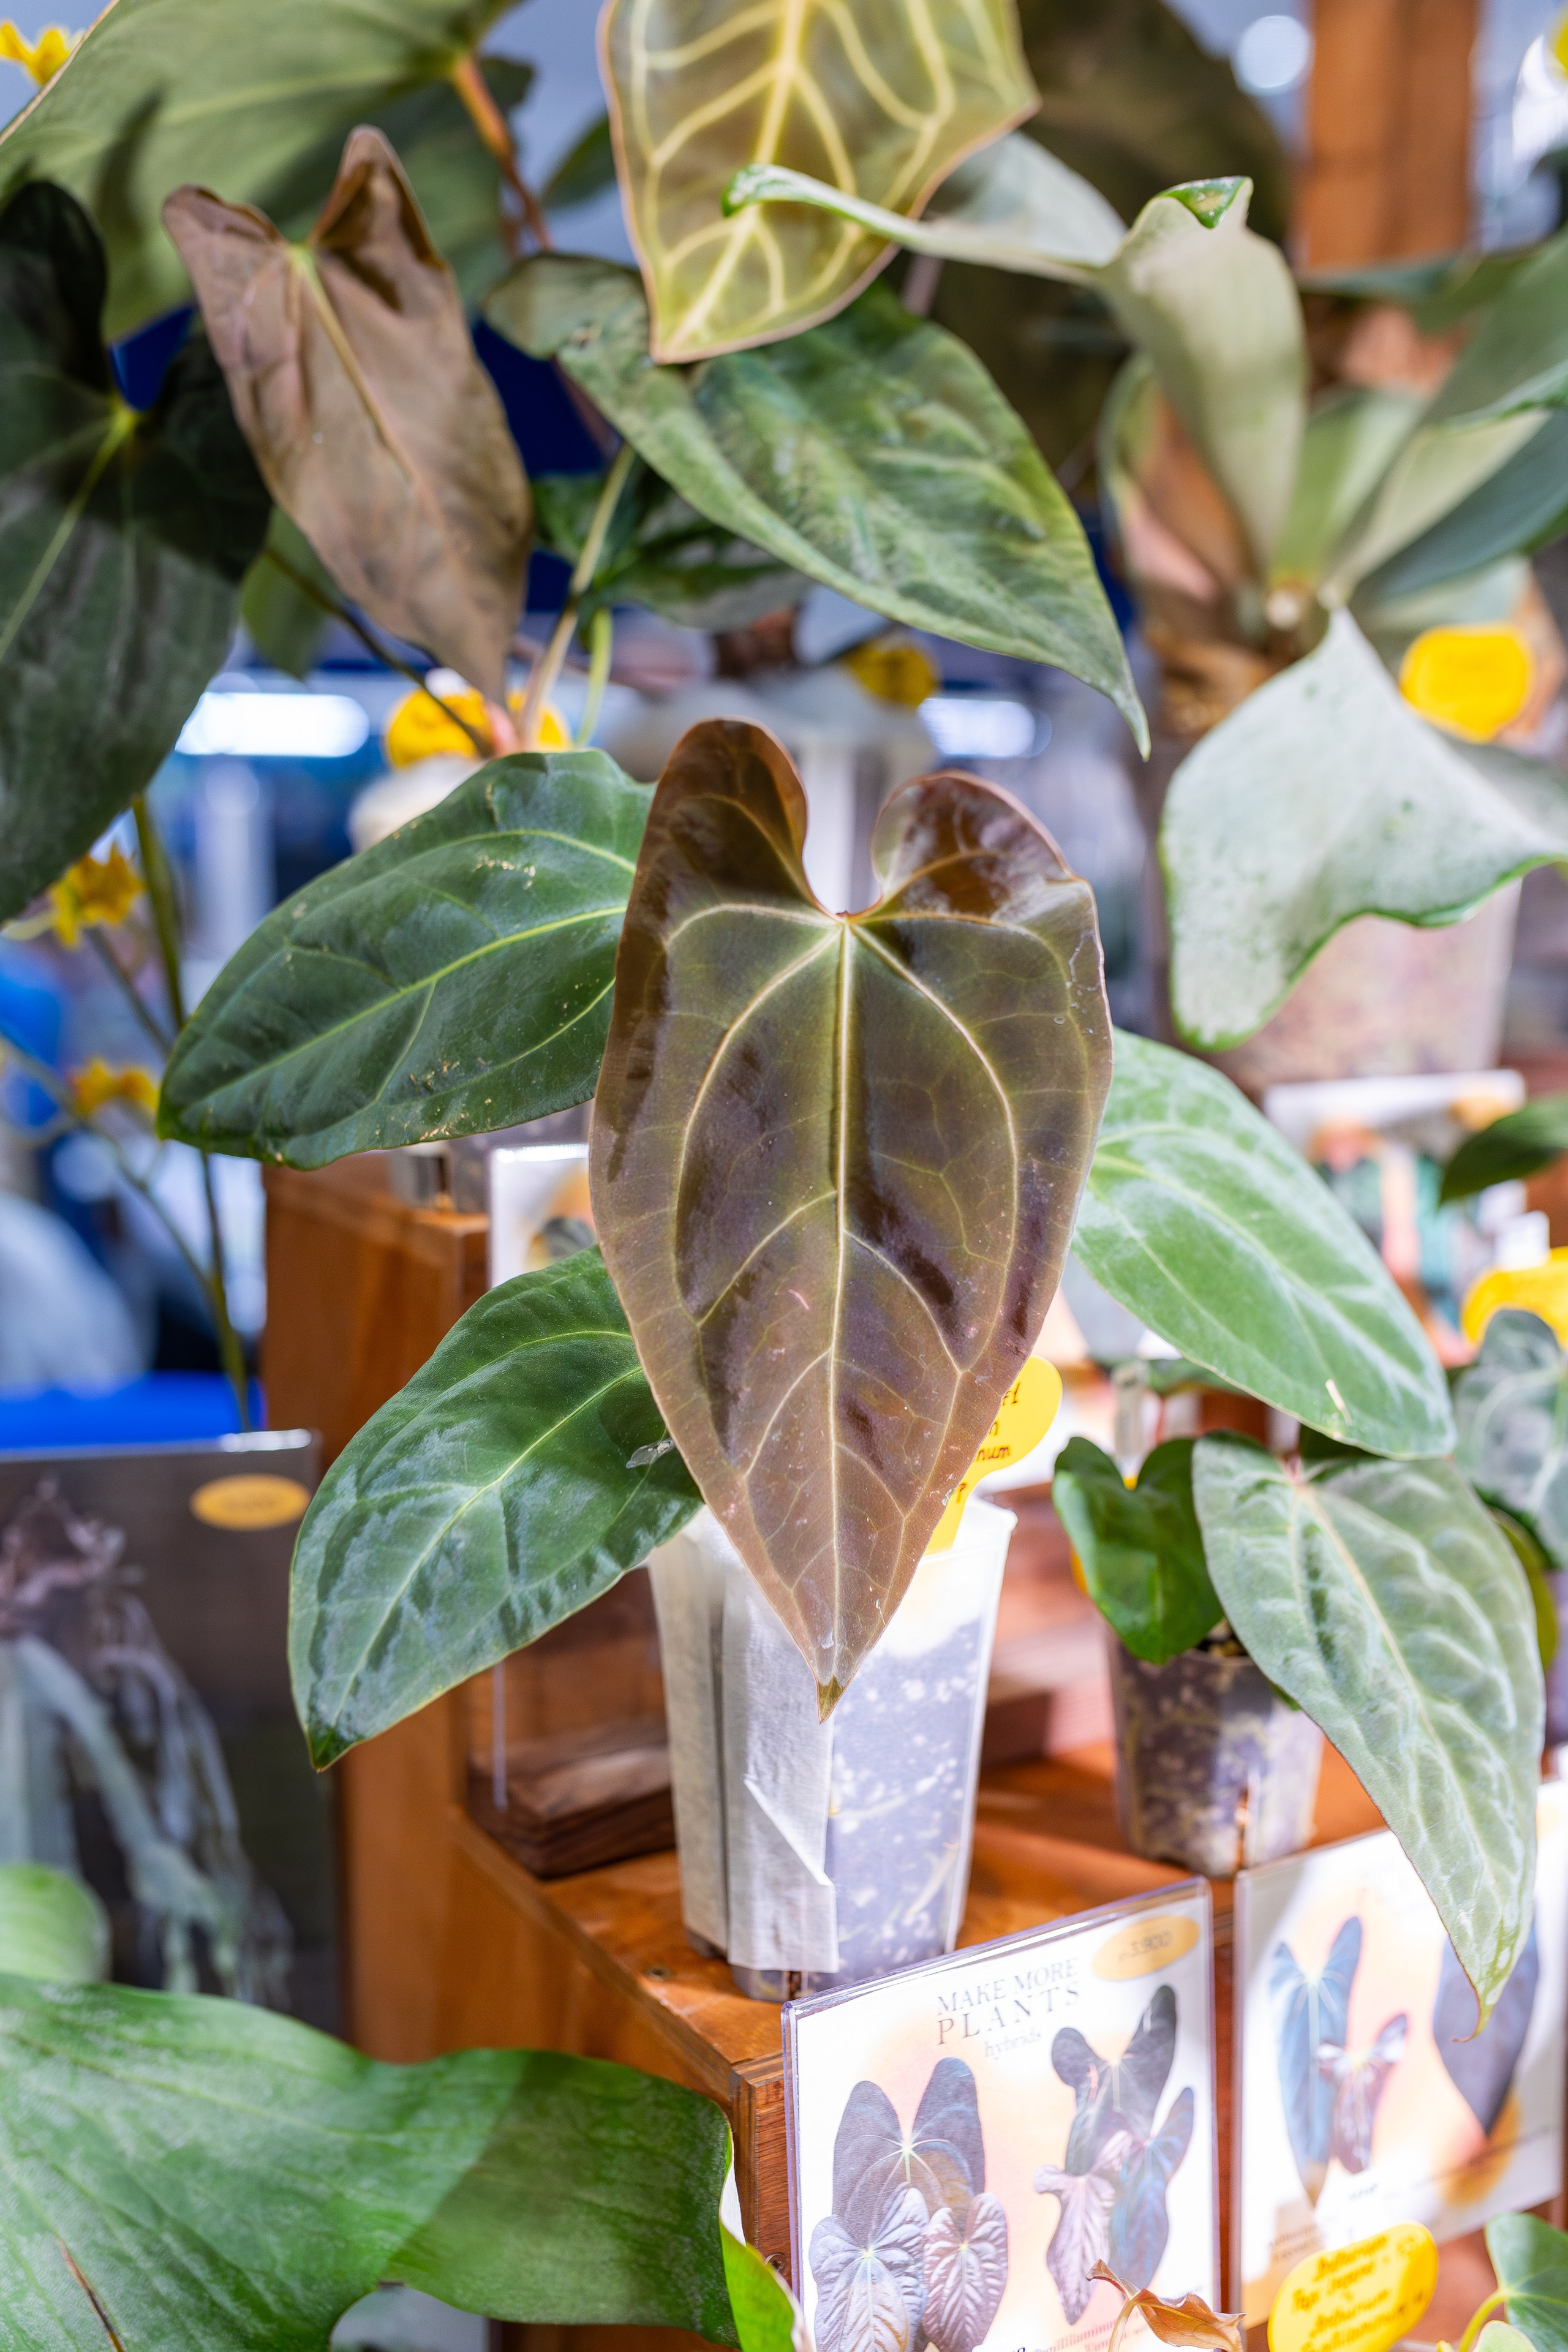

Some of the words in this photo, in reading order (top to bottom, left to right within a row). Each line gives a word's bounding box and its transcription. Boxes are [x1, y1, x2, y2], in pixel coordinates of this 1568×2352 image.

[938, 1979, 1006, 2016] MAKE
[1014, 1957, 1079, 1994] MORE
[938, 1981, 1079, 2045] PLANTS
